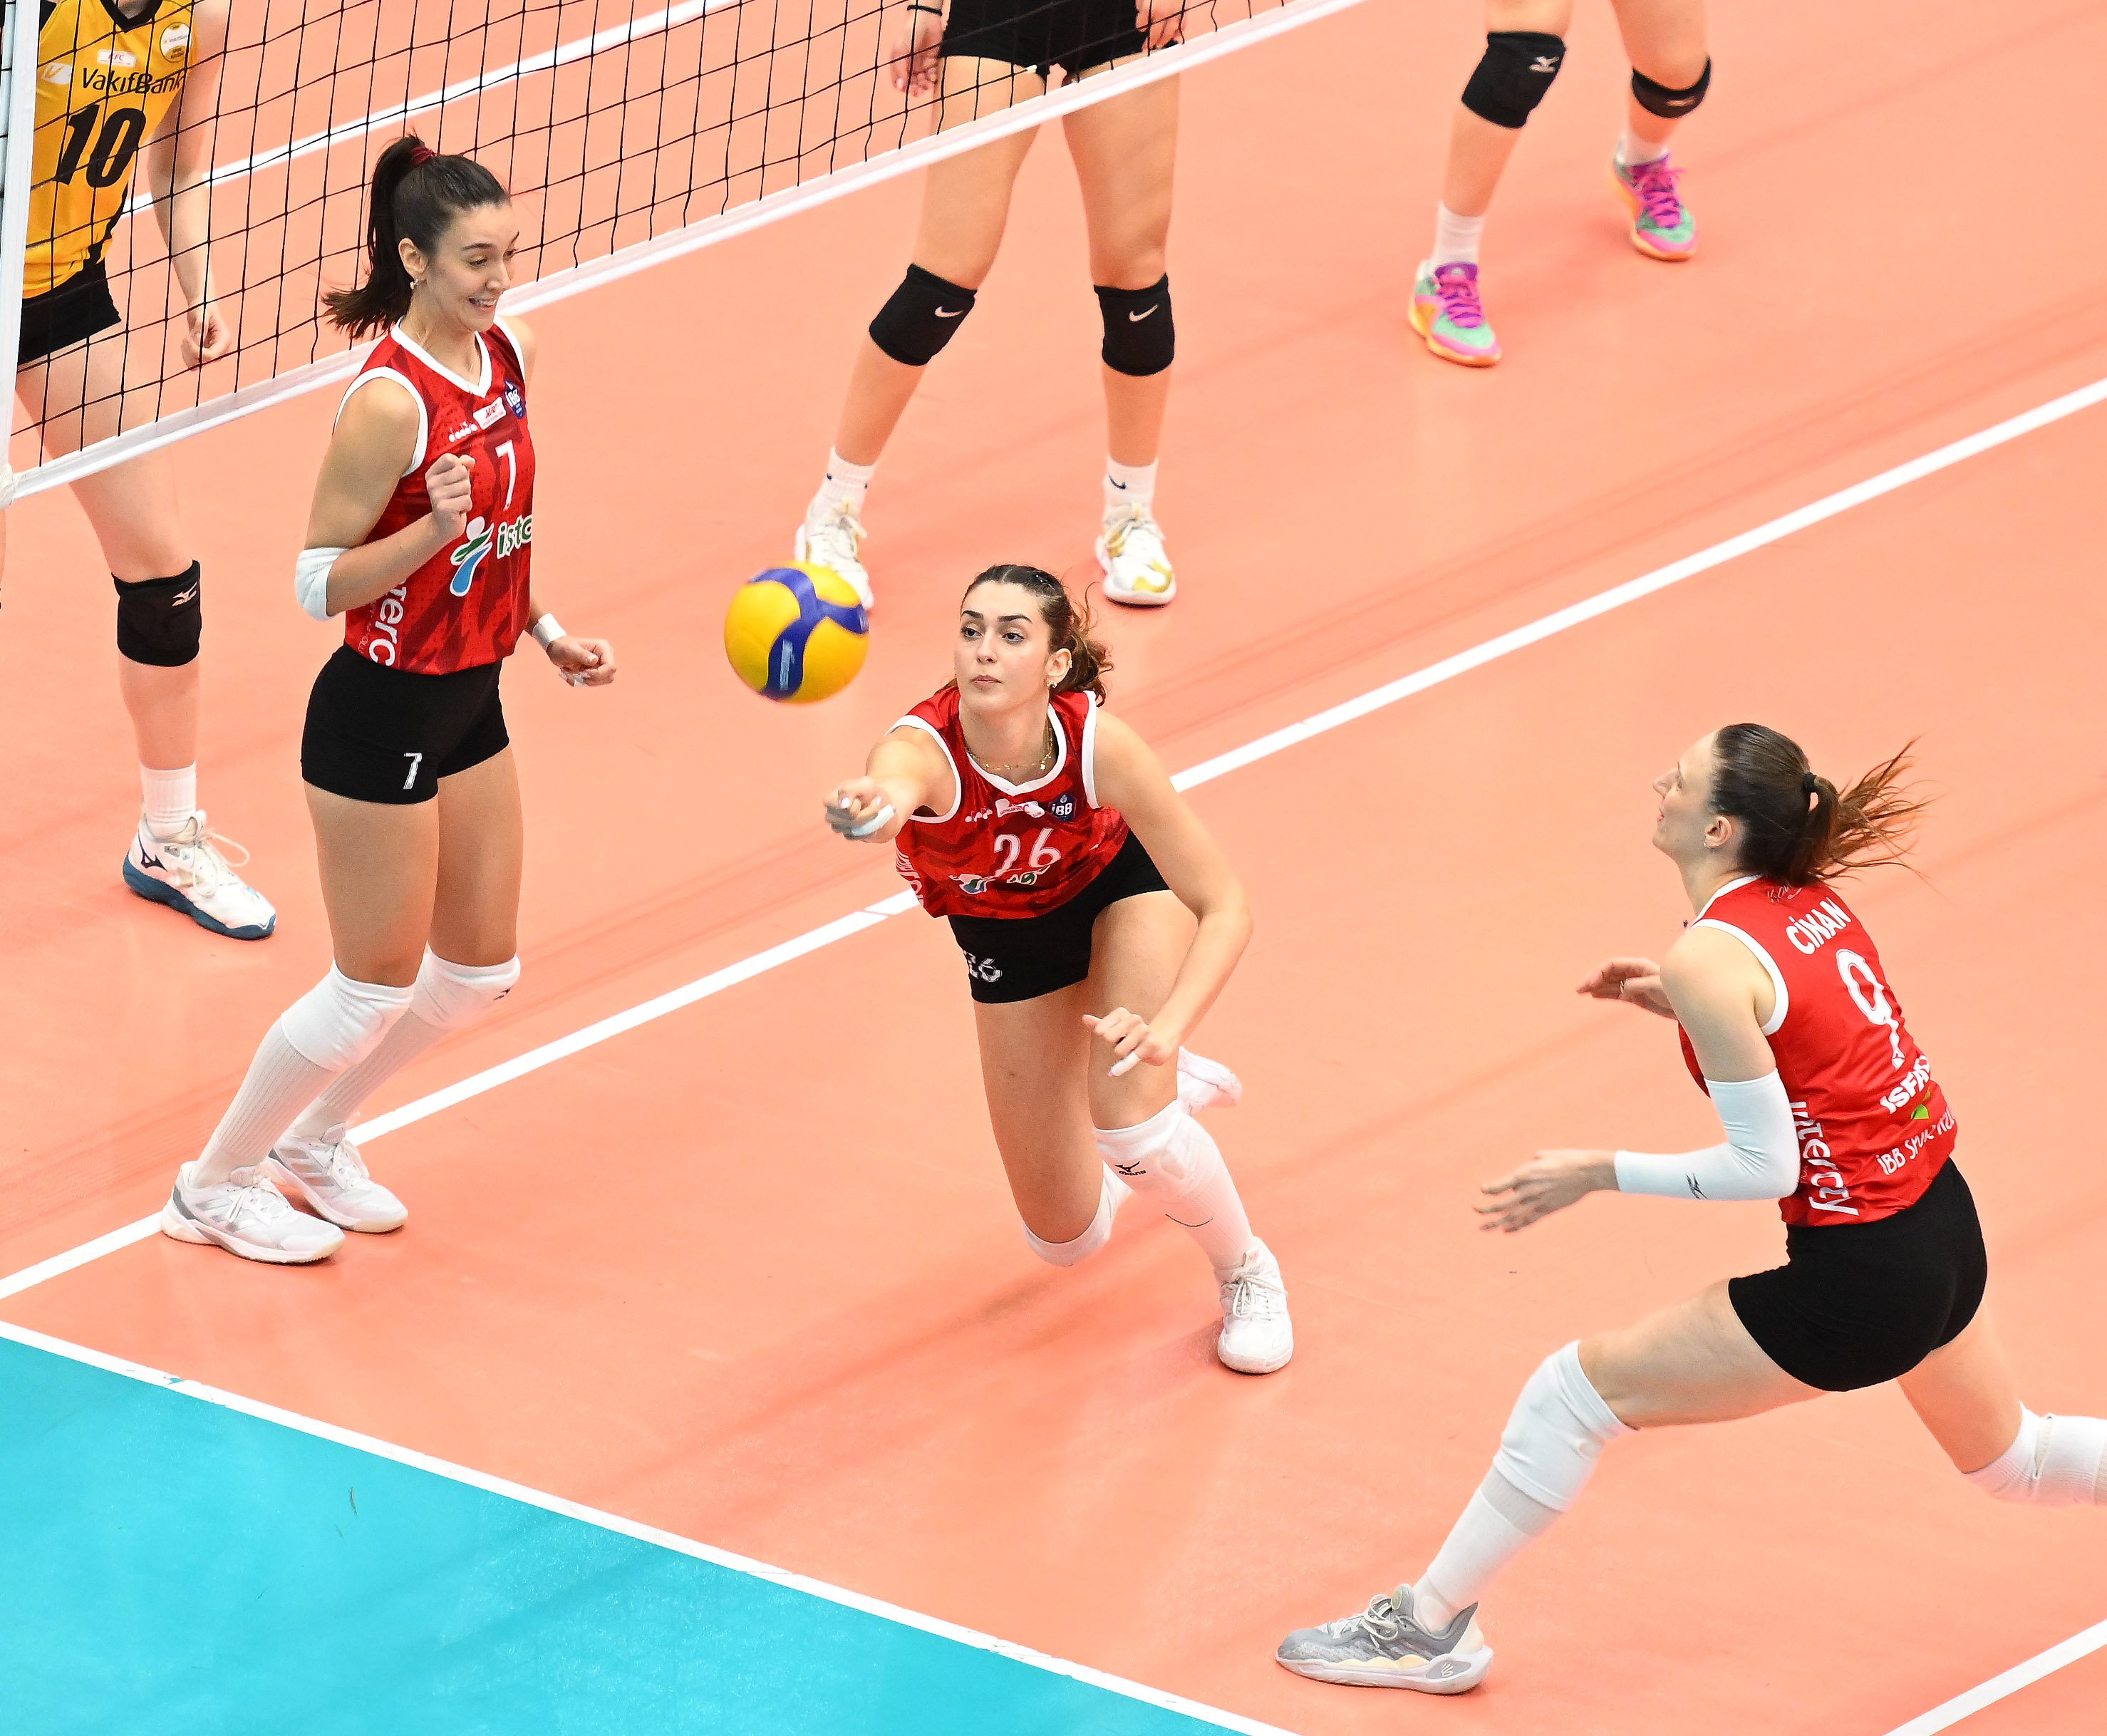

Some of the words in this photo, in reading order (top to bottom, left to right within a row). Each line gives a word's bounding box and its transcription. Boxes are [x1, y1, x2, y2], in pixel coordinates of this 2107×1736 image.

[56, 104, 147, 188] 10
[495, 440, 516, 511] 7
[403, 752, 423, 790] 7
[993, 827, 1062, 871] 26
[1836, 949, 1905, 1070] 9
